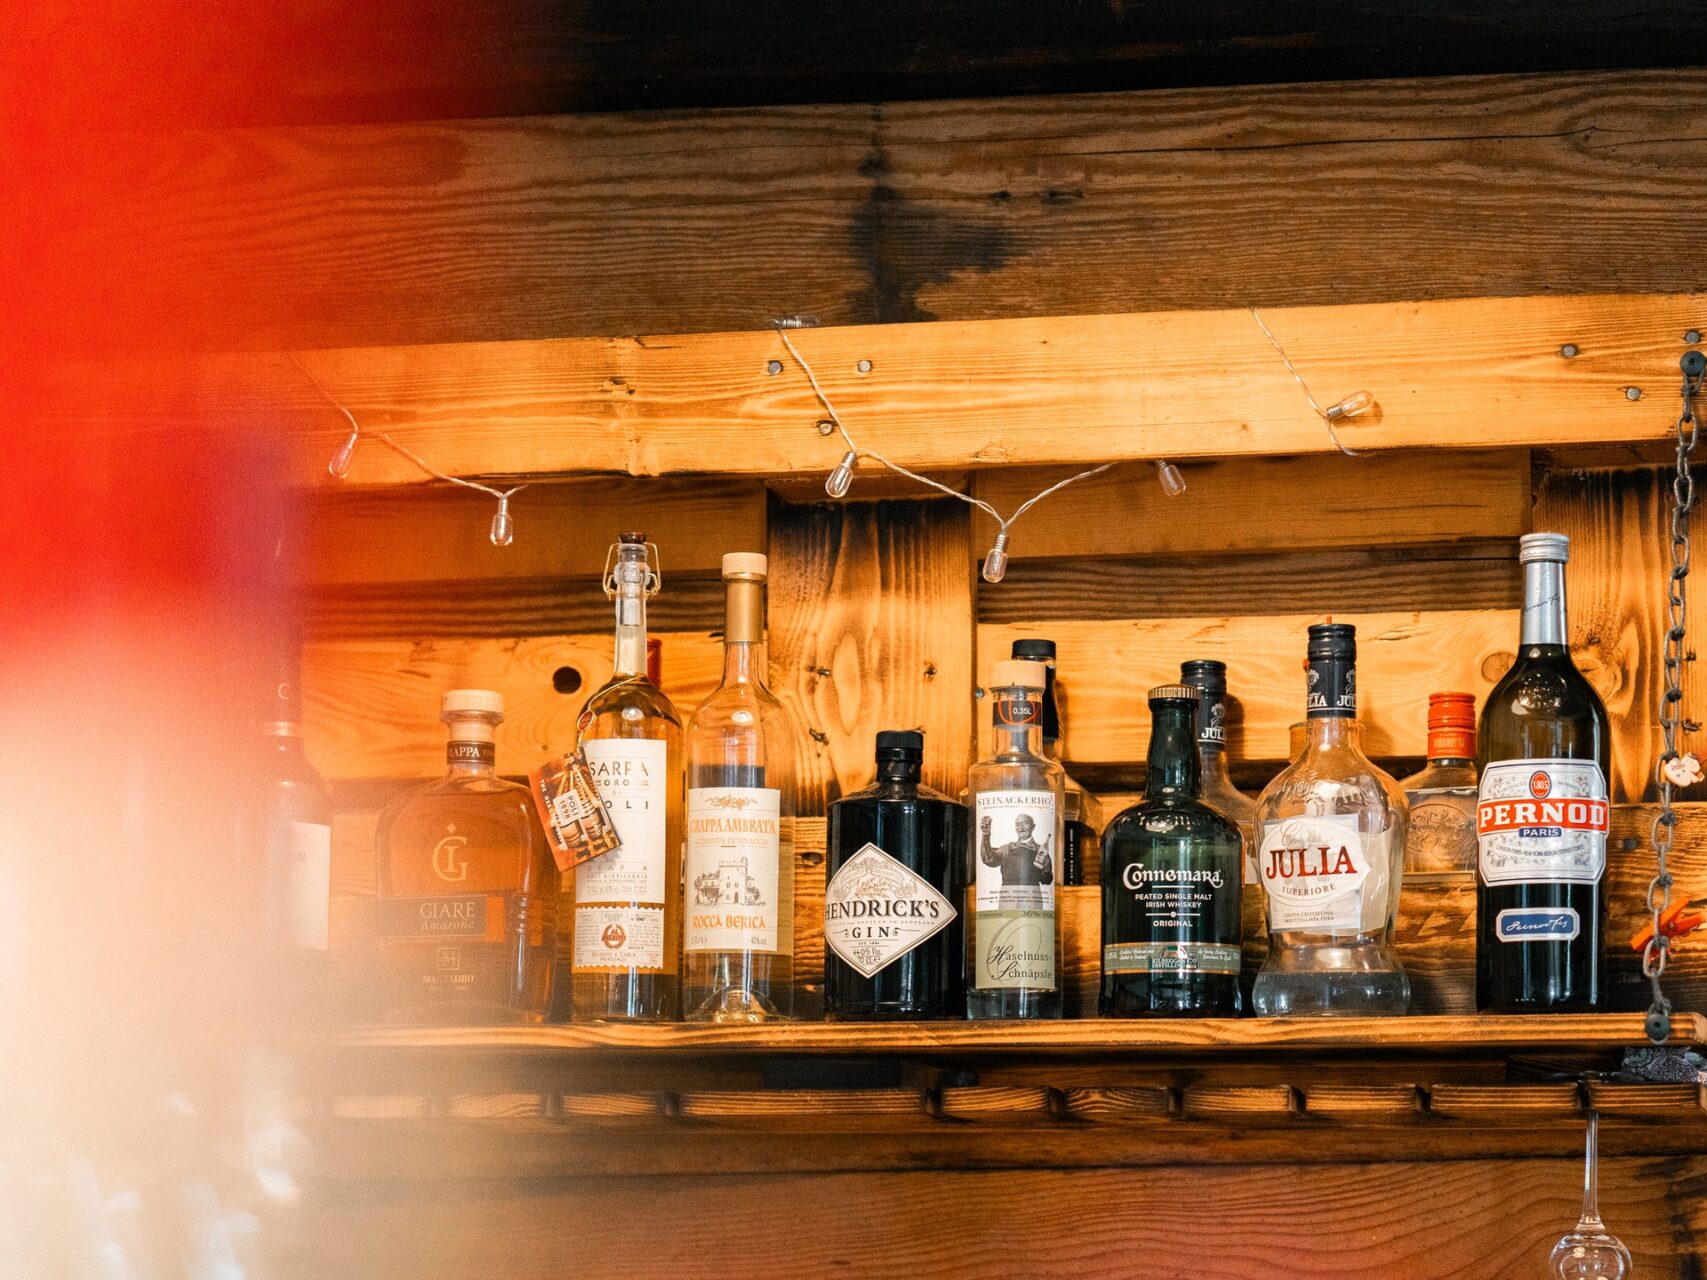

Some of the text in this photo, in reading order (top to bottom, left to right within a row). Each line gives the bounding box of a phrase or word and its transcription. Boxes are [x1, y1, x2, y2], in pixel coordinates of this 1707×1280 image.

[1012, 706, 1032, 716] 0,35L
[1532, 779, 1549, 791] 1805
[567, 794, 580, 817] POLI
[604, 800, 649, 811] OLI
[976, 795, 1053, 807] STEINACKERHO
[1479, 802, 1606, 828] PERNOD
[689, 817, 777, 835] GRAPPA AMBRATA
[1523, 828, 1560, 838] PARIS
[1265, 845, 1358, 880] JULIA
[1122, 862, 1224, 890] Connemara
[1281, 882, 1337, 897] SUPERIORE
[419, 902, 476, 921] GIARE
[824, 899, 940, 920] HENDRICK'S
[1020, 910, 1041, 918] 36%
[420, 918, 475, 931] Amarone
[692, 914, 767, 930] ROCCA BERICA
[852, 926, 890, 939] GIN
[990, 960, 1053, 981] Schnäpsle
